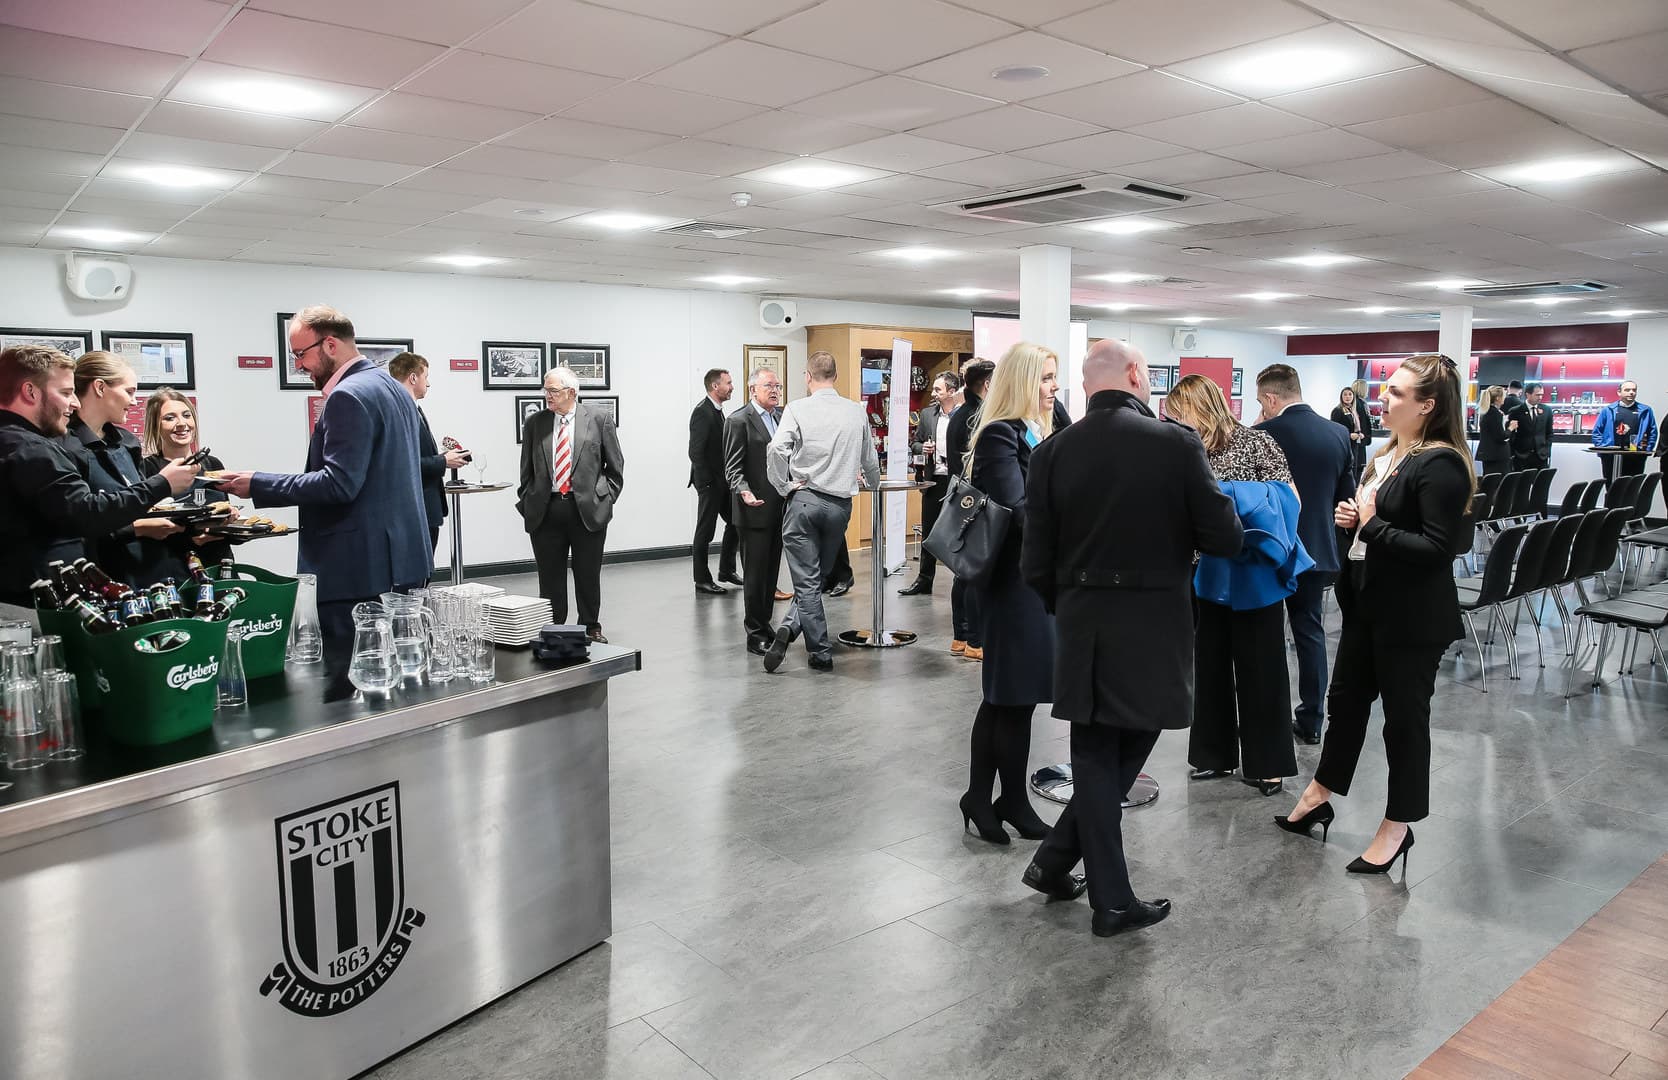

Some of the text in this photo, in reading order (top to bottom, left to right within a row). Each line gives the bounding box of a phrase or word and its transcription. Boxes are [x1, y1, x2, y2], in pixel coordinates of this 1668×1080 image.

[166, 655, 220, 691] Carlsberg
[287, 796, 392, 855] STOKE
[316, 833, 369, 867] CITY
[289, 942, 403, 1011] THE POTTERS
[327, 946, 370, 978] 1863
